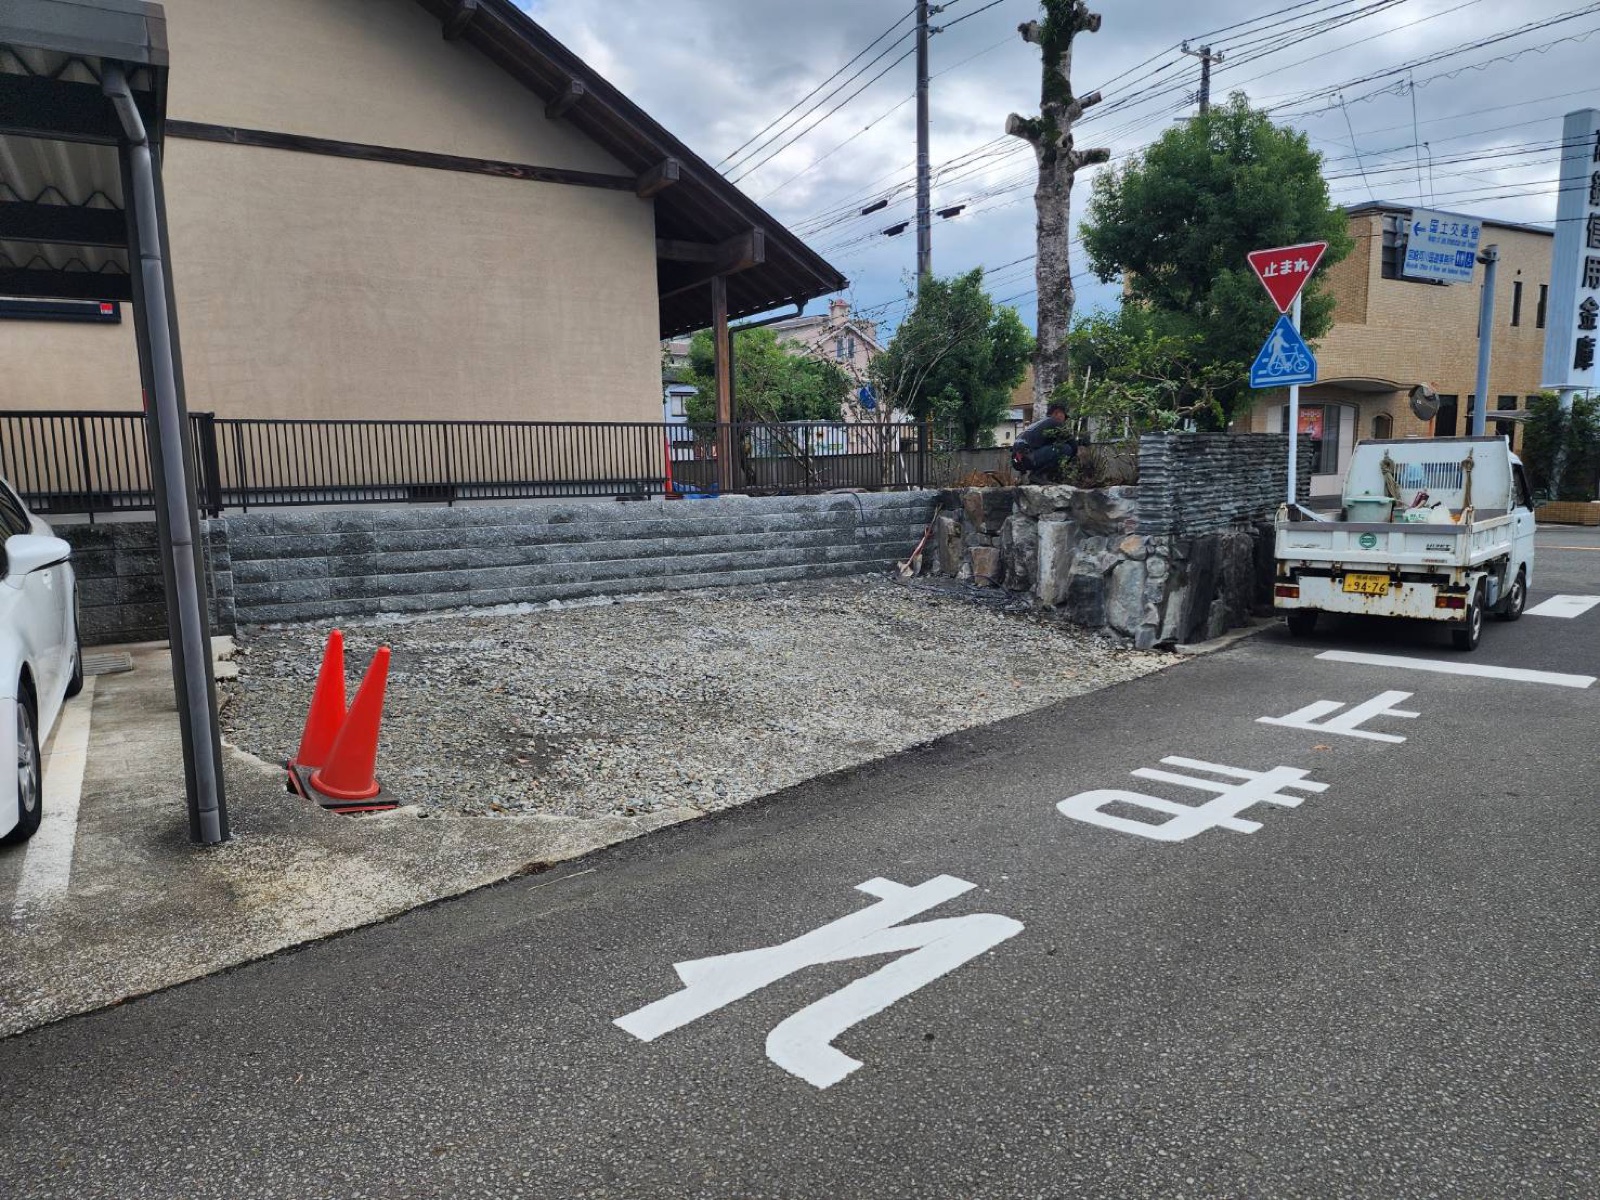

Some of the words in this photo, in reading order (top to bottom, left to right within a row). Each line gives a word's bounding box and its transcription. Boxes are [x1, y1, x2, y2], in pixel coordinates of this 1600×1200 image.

[1574, 129, 1600, 371] 信用金庫
[1262, 257, 1310, 277] 止まれ
[1353, 581, 1386, 593] 94-76
